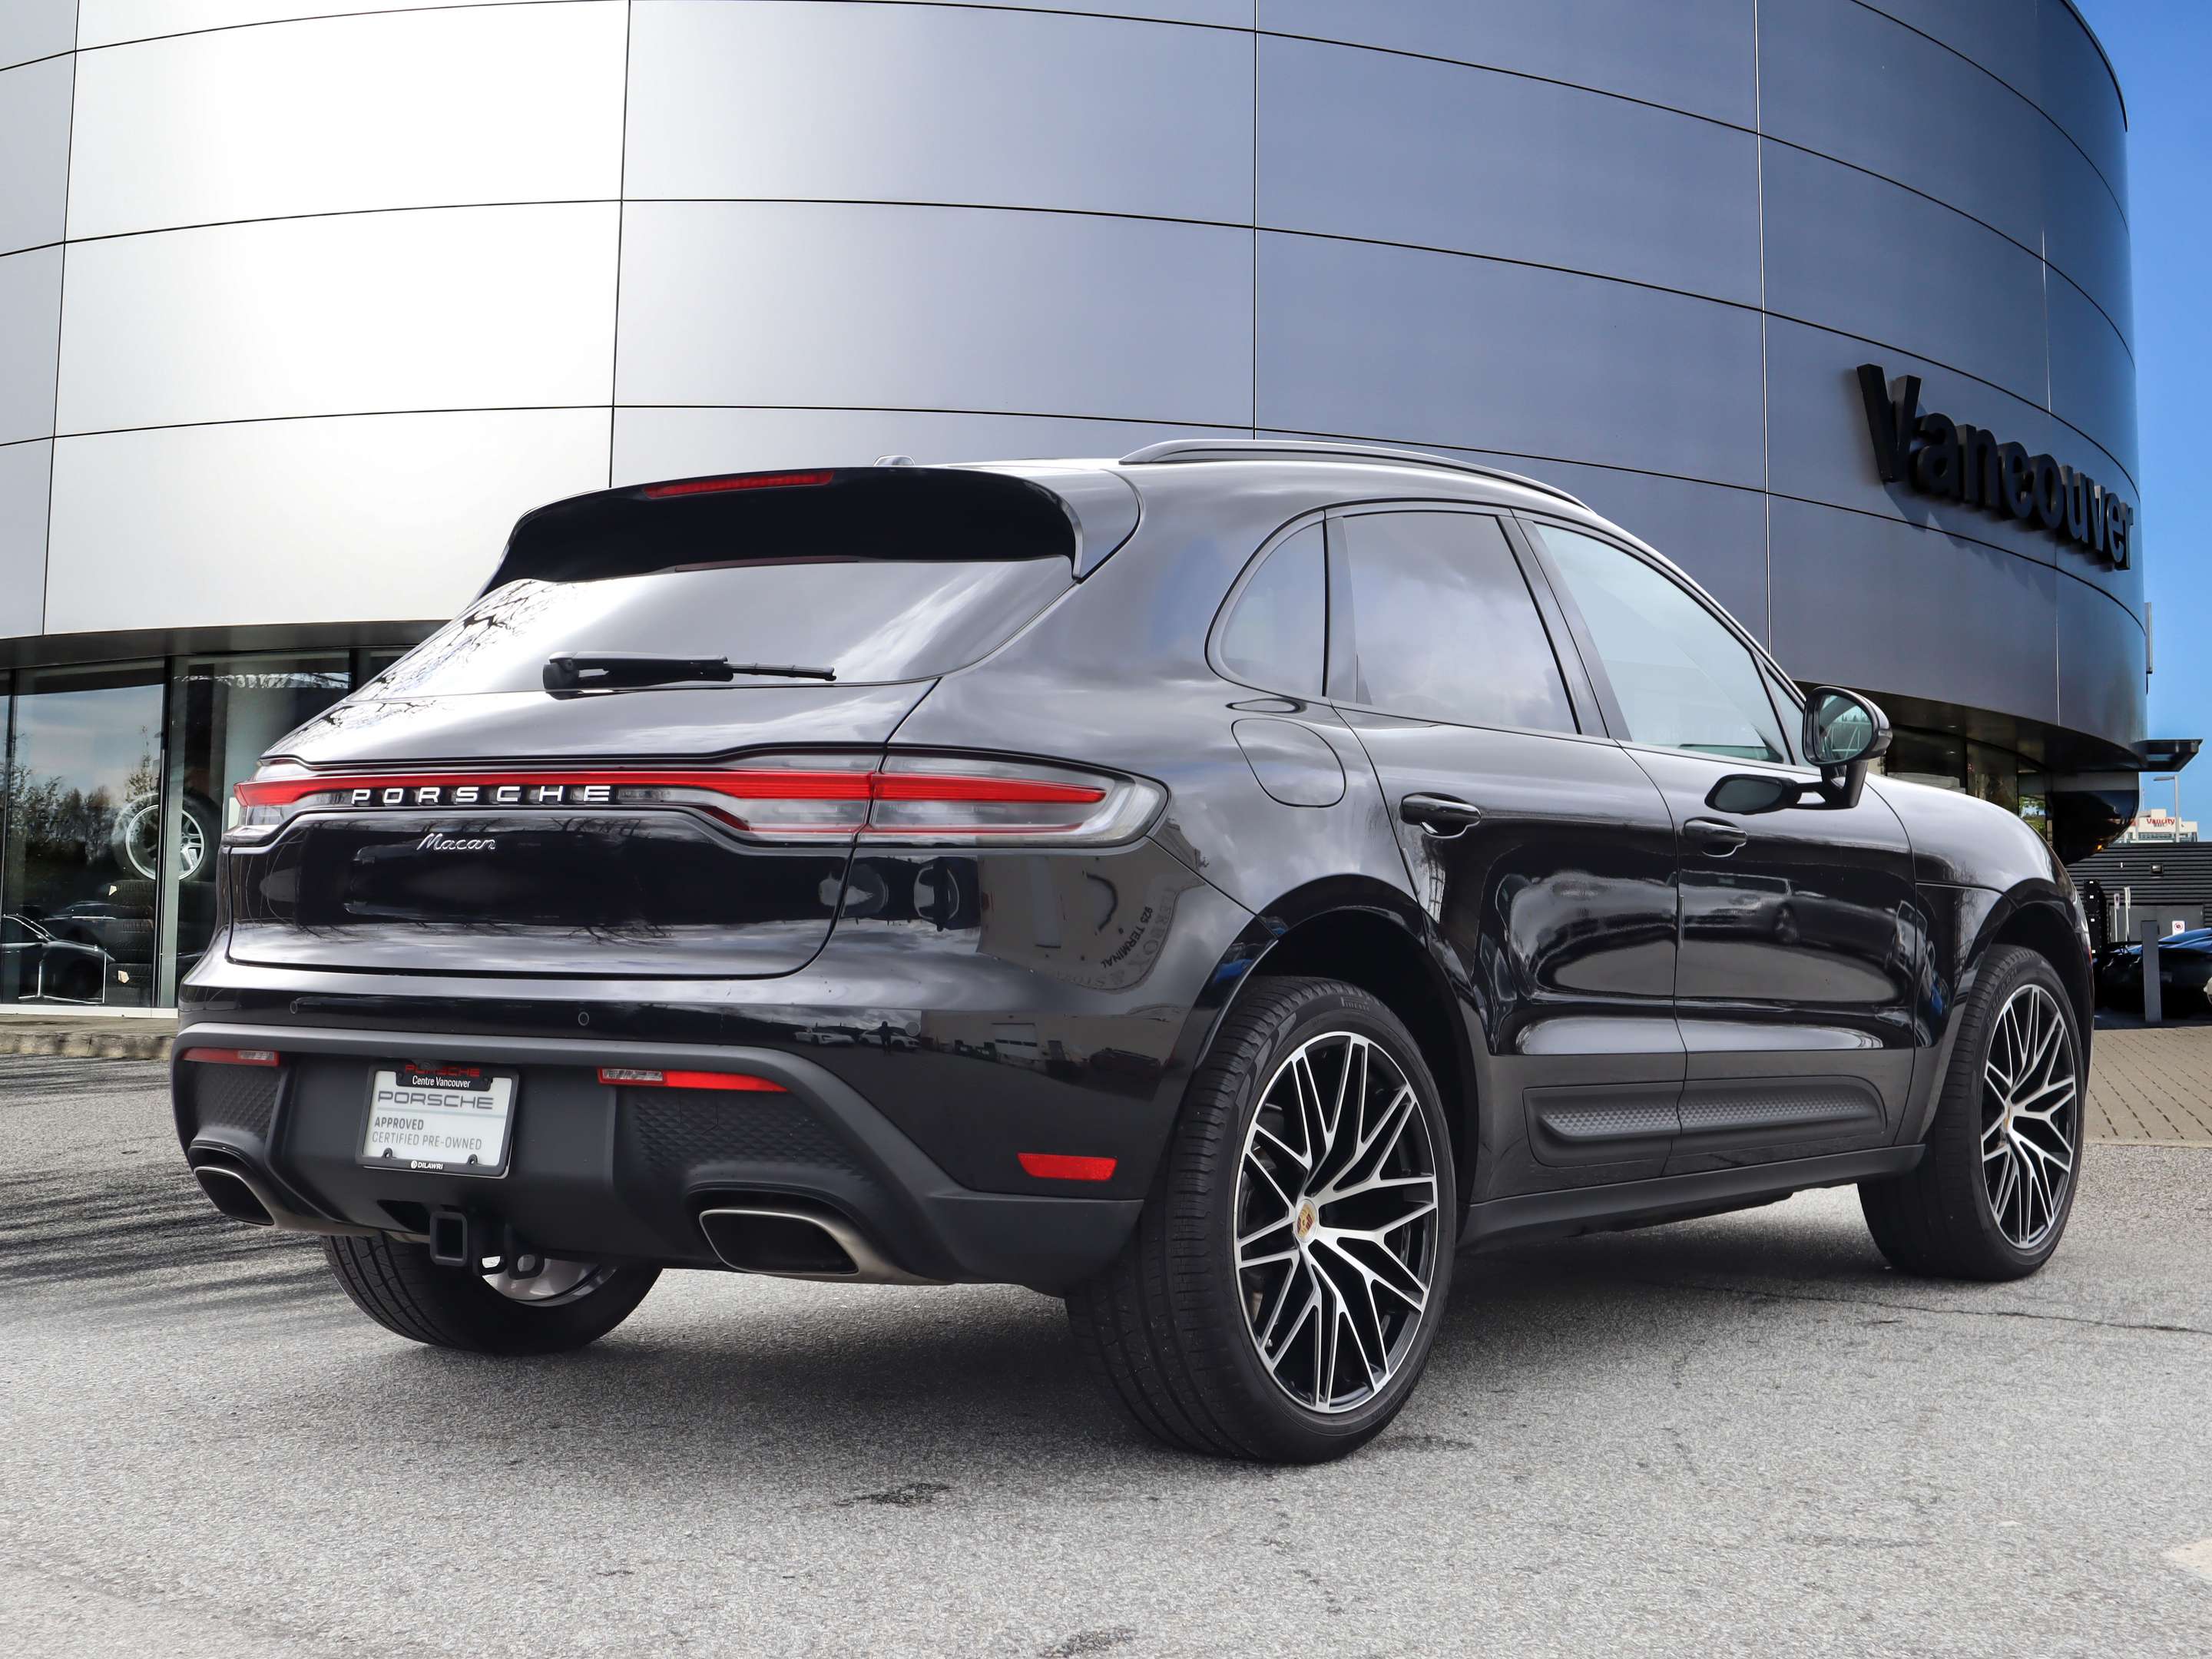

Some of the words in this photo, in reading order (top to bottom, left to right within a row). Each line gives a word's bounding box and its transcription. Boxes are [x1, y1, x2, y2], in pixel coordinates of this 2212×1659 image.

[1856, 363, 2134, 571] Vancouver
[351, 786, 611, 804] PORSCHE
[416, 833, 497, 851] Macan
[1100, 926, 1146, 969] TERMINAL
[412, 1075, 435, 1086] Centre
[435, 1076, 472, 1088] Vancouver
[377, 1091, 495, 1110] PORSCHE
[374, 1116, 424, 1131] APPROVED
[372, 1131, 419, 1146] CERTIFIED
[422, 1134, 482, 1151] PRE-OWNED
[417, 1161, 444, 1171] DILAWRI
